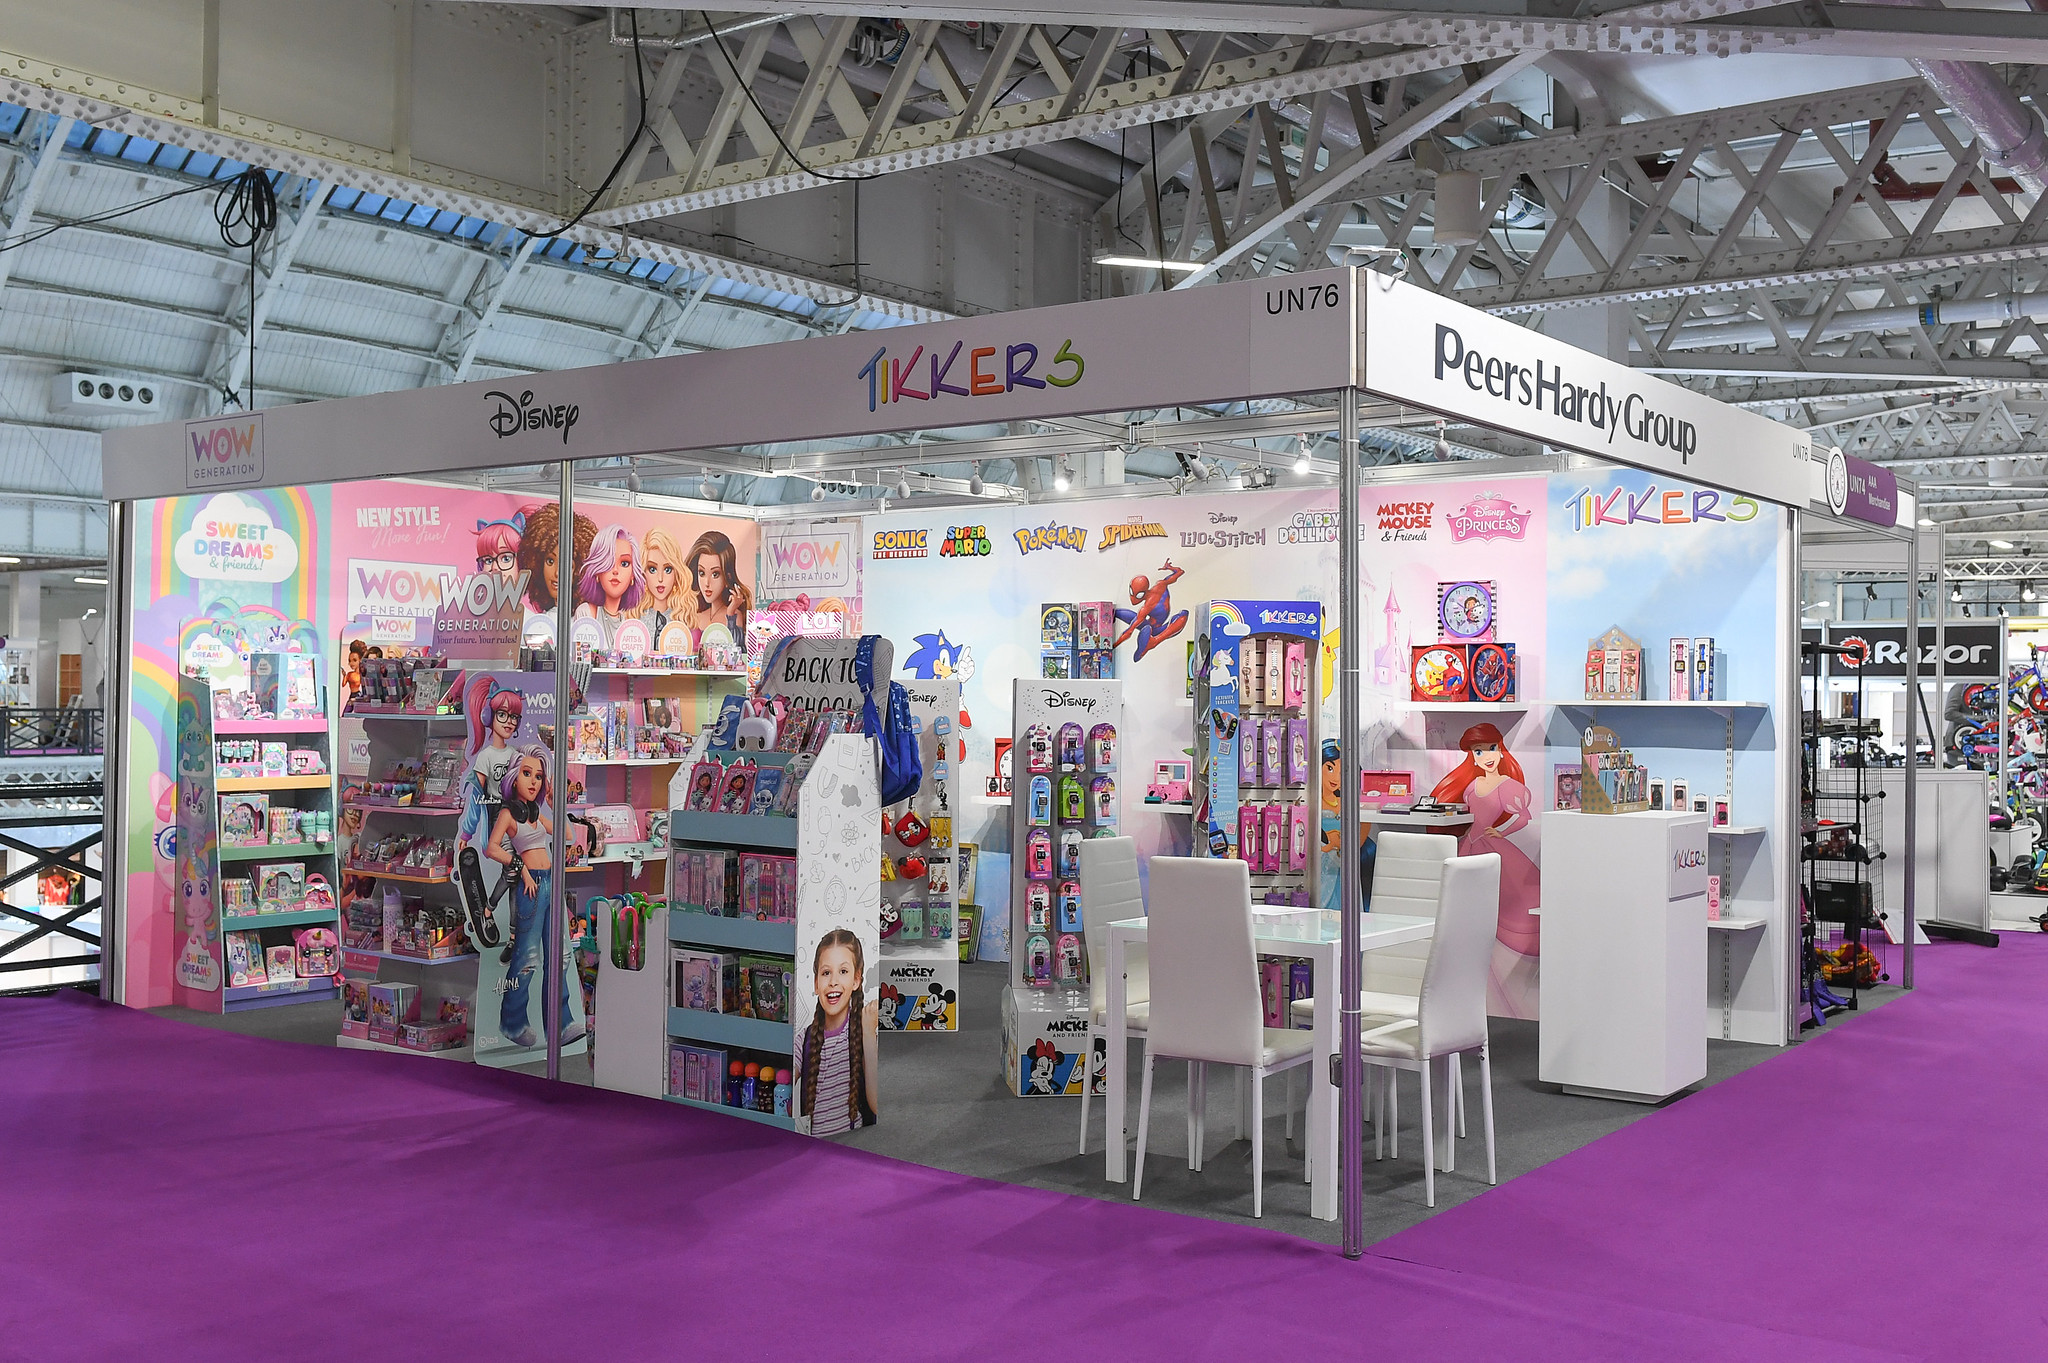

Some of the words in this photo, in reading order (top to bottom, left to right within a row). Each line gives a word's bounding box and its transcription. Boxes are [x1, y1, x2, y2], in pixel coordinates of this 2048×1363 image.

[1265, 283, 1340, 316] UN76
[858, 339, 1085, 412] TIKKERS
[484, 390, 579, 445] Disney
[191, 424, 255, 463] WOW
[1792, 443, 1809, 462] UN76
[194, 464, 255, 479] GENERATION
[1849, 474, 1866, 495] UN74
[1868, 475, 1878, 489] AAA
[1377, 502, 1434, 516] MICKEY
[1565, 486, 1759, 531] TIKKERS
[1868, 492, 1891, 511] Merchandise
[356, 507, 392, 528] NEW
[393, 506, 441, 527] STYLE
[1207, 512, 1238, 525] Disney
[1471, 505, 1506, 518] Disney
[206, 521, 268, 541] SWEET
[1378, 516, 1432, 530] MOUSE
[1455, 517, 1521, 538] PRINCESS
[873, 529, 928, 550] SONIC
[947, 525, 986, 540] SUPER
[1381, 531, 1392, 542] &
[1394, 529, 1428, 542] Friends
[194, 539, 274, 560] DREAMS
[772, 541, 840, 570] WOW
[874, 551, 886, 559] THE
[889, 550, 928, 558] HEDGEHOG
[940, 538, 991, 557] MARIO
[209, 556, 219, 569] &
[222, 553, 265, 573] friends!
[775, 572, 839, 581] GENERATION
[440, 573, 527, 616] WOW
[359, 604, 435, 618] GENERATIO
[1259, 609, 1318, 625] TIKKERS
[375, 619, 412, 632] WOW
[438, 618, 520, 631] GENERATION
[436, 635, 453, 645] Your
[453, 634, 477, 645] future.
[478, 635, 496, 645] Your
[496, 634, 518, 645] rules!
[621, 643, 644, 651] CRAFTS
[784, 657, 834, 684] BACK
[1041, 689, 1097, 713] Disney
[350, 743, 368, 757] WO
[1673, 849, 1706, 872] TIKKERS
[186, 952, 210, 965] SWEET
[182, 963, 212, 977] DREAMS
[890, 967, 936, 977] MICKEY
[492, 977, 520, 994] ALANA
[1046, 1020, 1088, 1032] MICKE
